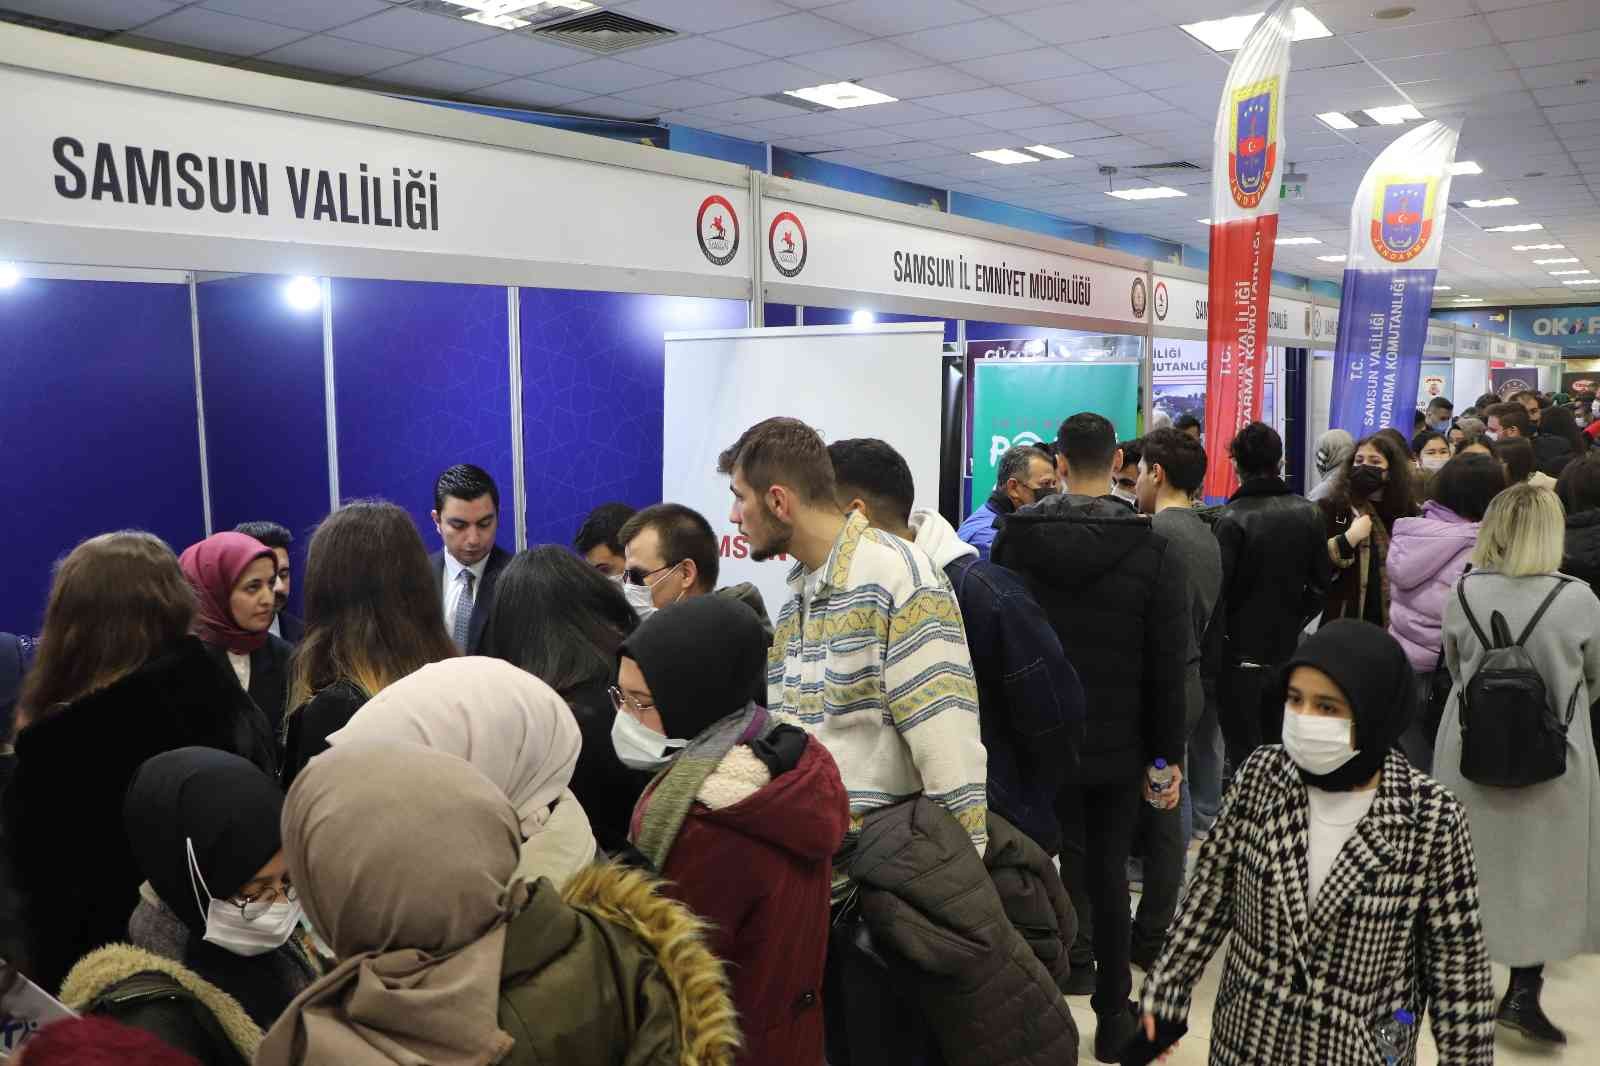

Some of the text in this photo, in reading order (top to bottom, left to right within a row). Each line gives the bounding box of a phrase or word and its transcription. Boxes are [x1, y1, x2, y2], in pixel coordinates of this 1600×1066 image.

[52, 136, 440, 231] SAMSUN VALİLİĞİ
[893, 250, 1092, 307] SAMSUN İL EMNİYET MÜDÜRLÜĞÜ
[1152, 346, 1181, 359] İLİĞİ
[1350, 358, 1365, 381] T.C.
[1363, 312, 1385, 426] SAMSUN VALİLİĞİ
[1379, 372, 1397, 430] NDARMA
